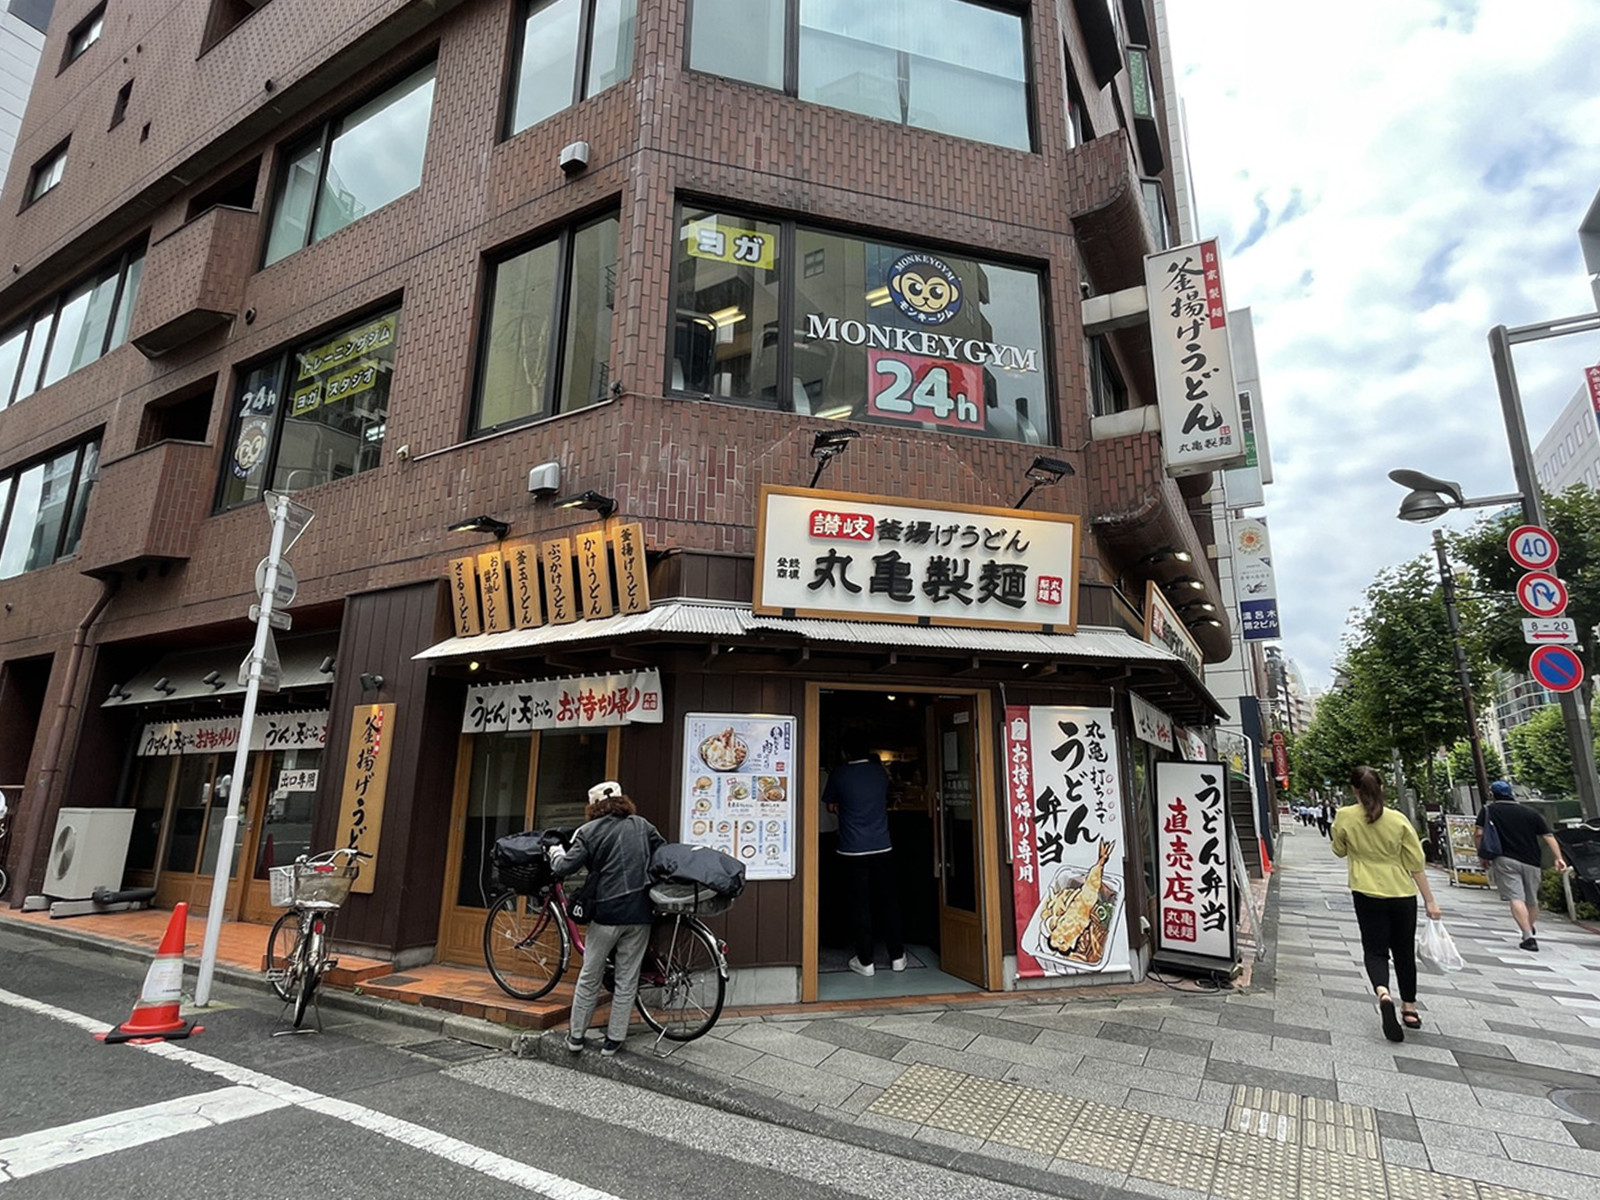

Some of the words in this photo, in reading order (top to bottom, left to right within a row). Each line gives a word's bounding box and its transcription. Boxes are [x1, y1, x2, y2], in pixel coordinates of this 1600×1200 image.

[696, 229, 763, 263] ヨガ
[894, 254, 955, 281] MONKEYGYM
[303, 325, 391, 374] トレーニングジム
[806, 314, 1039, 373] MONKEYGYM
[1162, 257, 1224, 435] 釜揚げうどん
[239, 386, 276, 418] 24h
[296, 388, 320, 410] ヨガ
[328, 366, 375, 397] スタジオ
[874, 357, 980, 423] 24h
[813, 512, 872, 539] 讃岐
[875, 518, 1030, 554] 釜揚げうどん
[1521, 538, 1548, 558] 40
[515, 550, 532, 624] 釜玉うどん
[548, 544, 566, 620] ぶっかけうどん
[584, 537, 602, 615] かけうどん
[620, 528, 640, 610] 釜揚げうどん
[807, 548, 1029, 610] 丸亀製麺
[1085, 720, 1108, 763] 丸亀
[280, 772, 316, 789] 出口専用
[1051, 720, 1100, 845] うどん
[1011, 742, 1034, 884] お持ち帰り専用
[1034, 786, 1067, 866] 弁当
[1163, 797, 1195, 905] 直売店
[1195, 773, 1228, 932] うどん弁当
